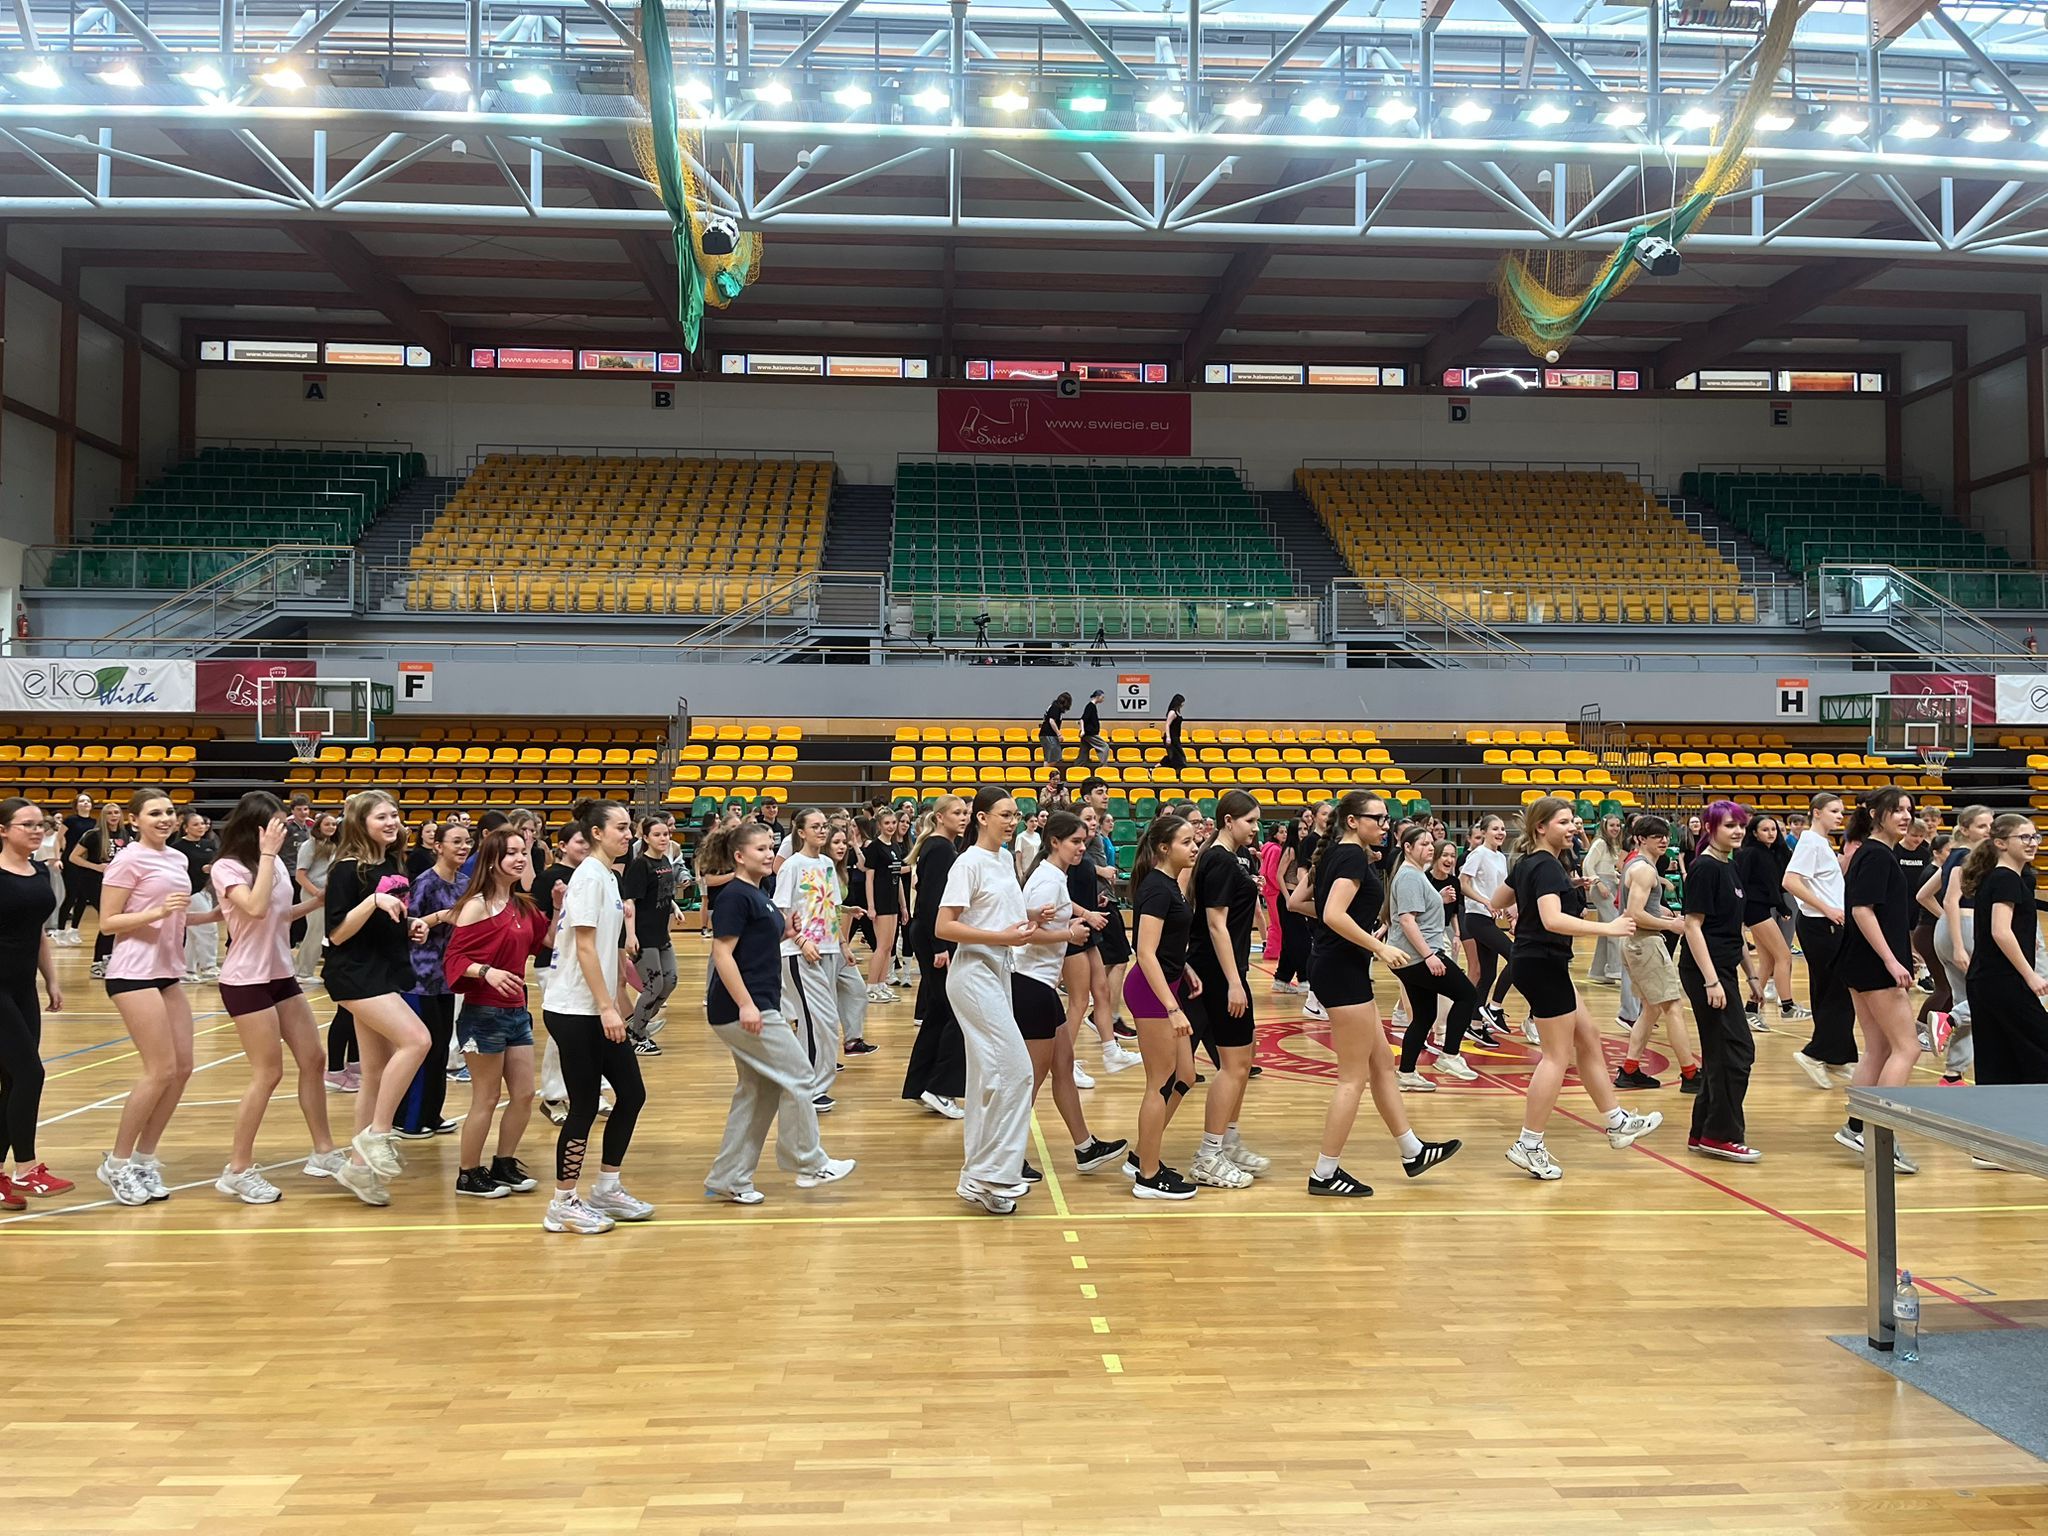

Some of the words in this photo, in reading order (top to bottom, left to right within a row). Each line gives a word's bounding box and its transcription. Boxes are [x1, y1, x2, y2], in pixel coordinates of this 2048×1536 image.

[305, 383, 324, 399] A
[1061, 379, 1076, 395] C
[655, 391, 671, 408] B
[1451, 405, 1467, 422] D
[1774, 410, 1788, 425] E
[1045, 418, 1170, 431] www.swiecie.eu
[22, 663, 98, 699] eko
[405, 674, 425, 698] F
[1128, 684, 1140, 695] G
[1120, 698, 1147, 710] VIP
[1781, 690, 1804, 712] H
